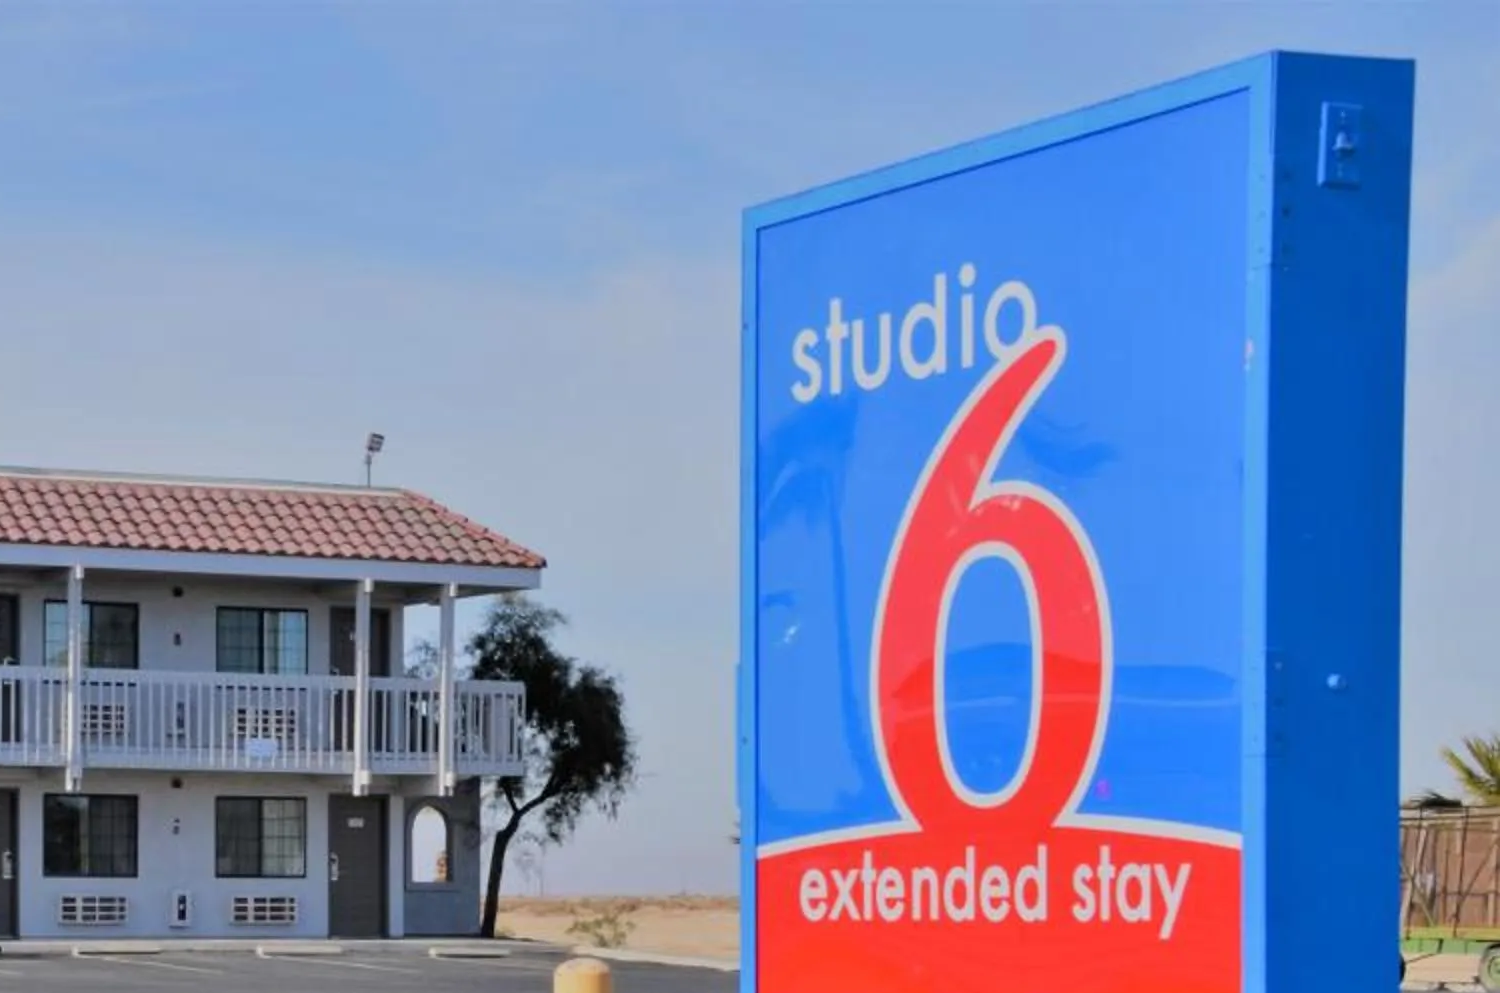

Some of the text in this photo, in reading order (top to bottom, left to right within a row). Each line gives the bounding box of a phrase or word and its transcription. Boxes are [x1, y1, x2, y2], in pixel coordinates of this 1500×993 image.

[790, 263, 1038, 404] studio
[870, 325, 1112, 830] 6
[799, 842, 1191, 939] extended stay
